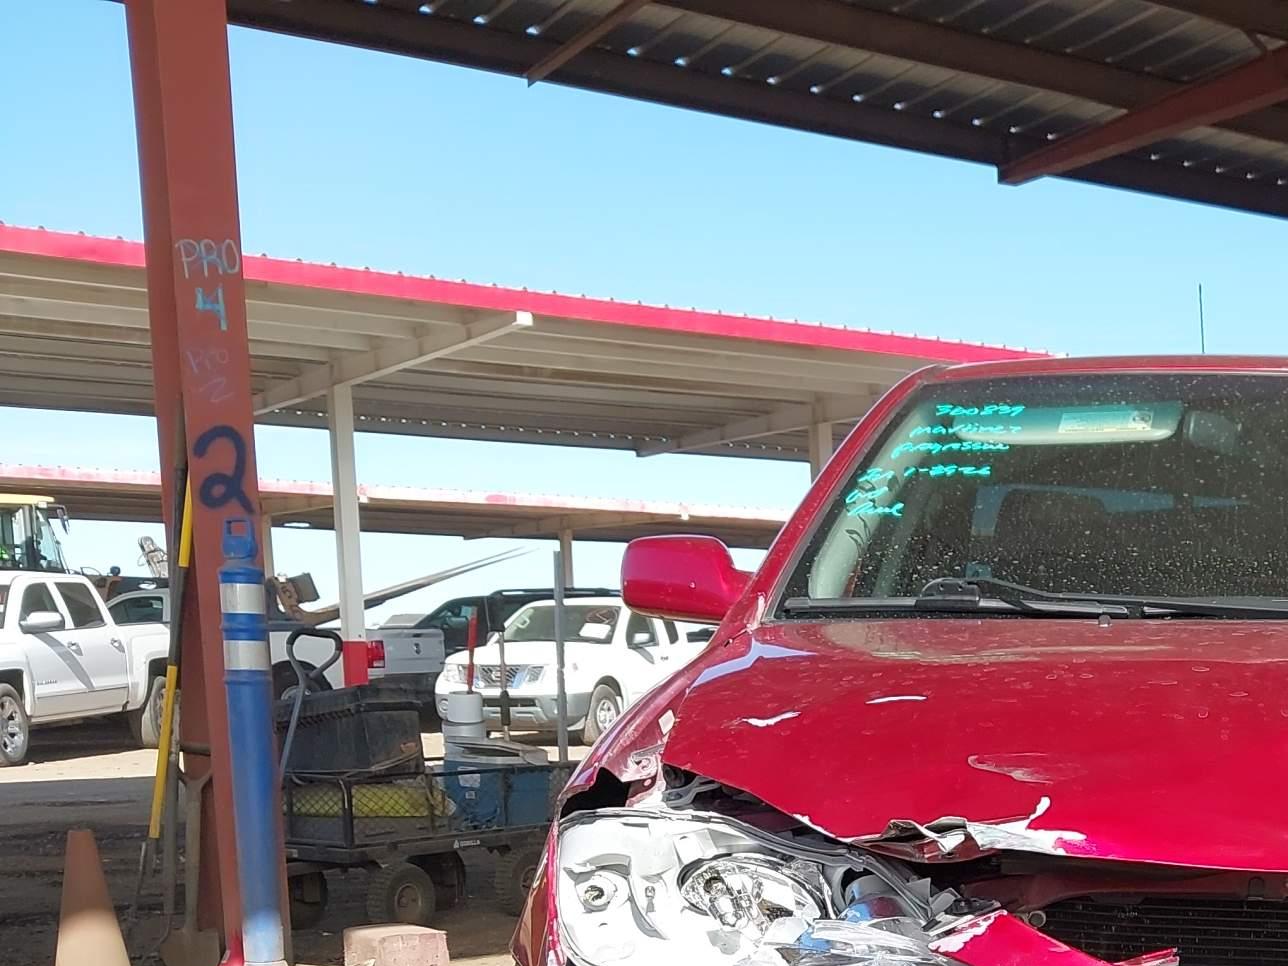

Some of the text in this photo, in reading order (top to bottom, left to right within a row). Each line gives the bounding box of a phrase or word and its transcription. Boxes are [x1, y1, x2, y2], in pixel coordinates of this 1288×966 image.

[175, 239, 241, 279] PRO
[195, 282, 228, 332] 4
[193, 424, 255, 514] 2
